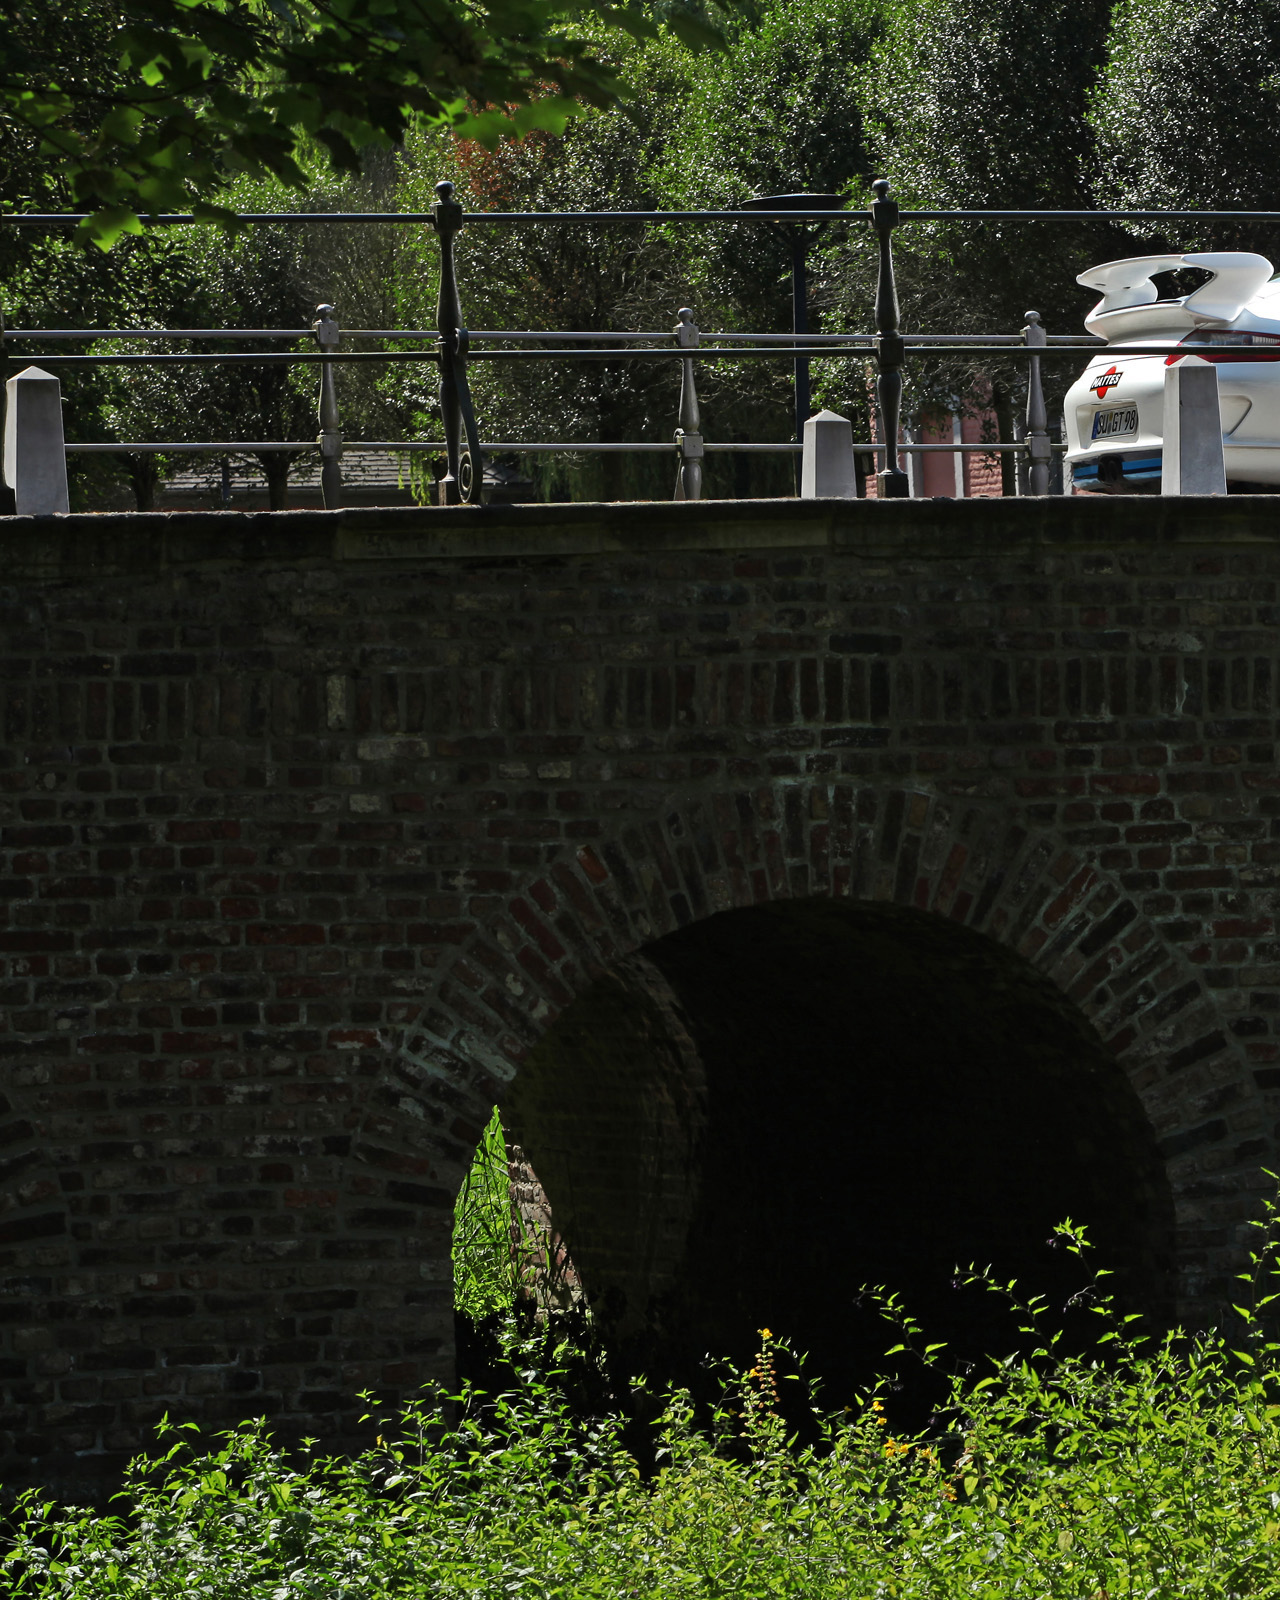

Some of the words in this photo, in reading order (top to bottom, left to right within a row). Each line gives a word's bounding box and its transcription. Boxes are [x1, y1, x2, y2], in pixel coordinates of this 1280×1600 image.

[1091, 374, 1121, 388] MATTES
[1097, 414, 1109, 435] SU
[1112, 411, 1125, 432] GT
[1124, 409, 1136, 431] 98
